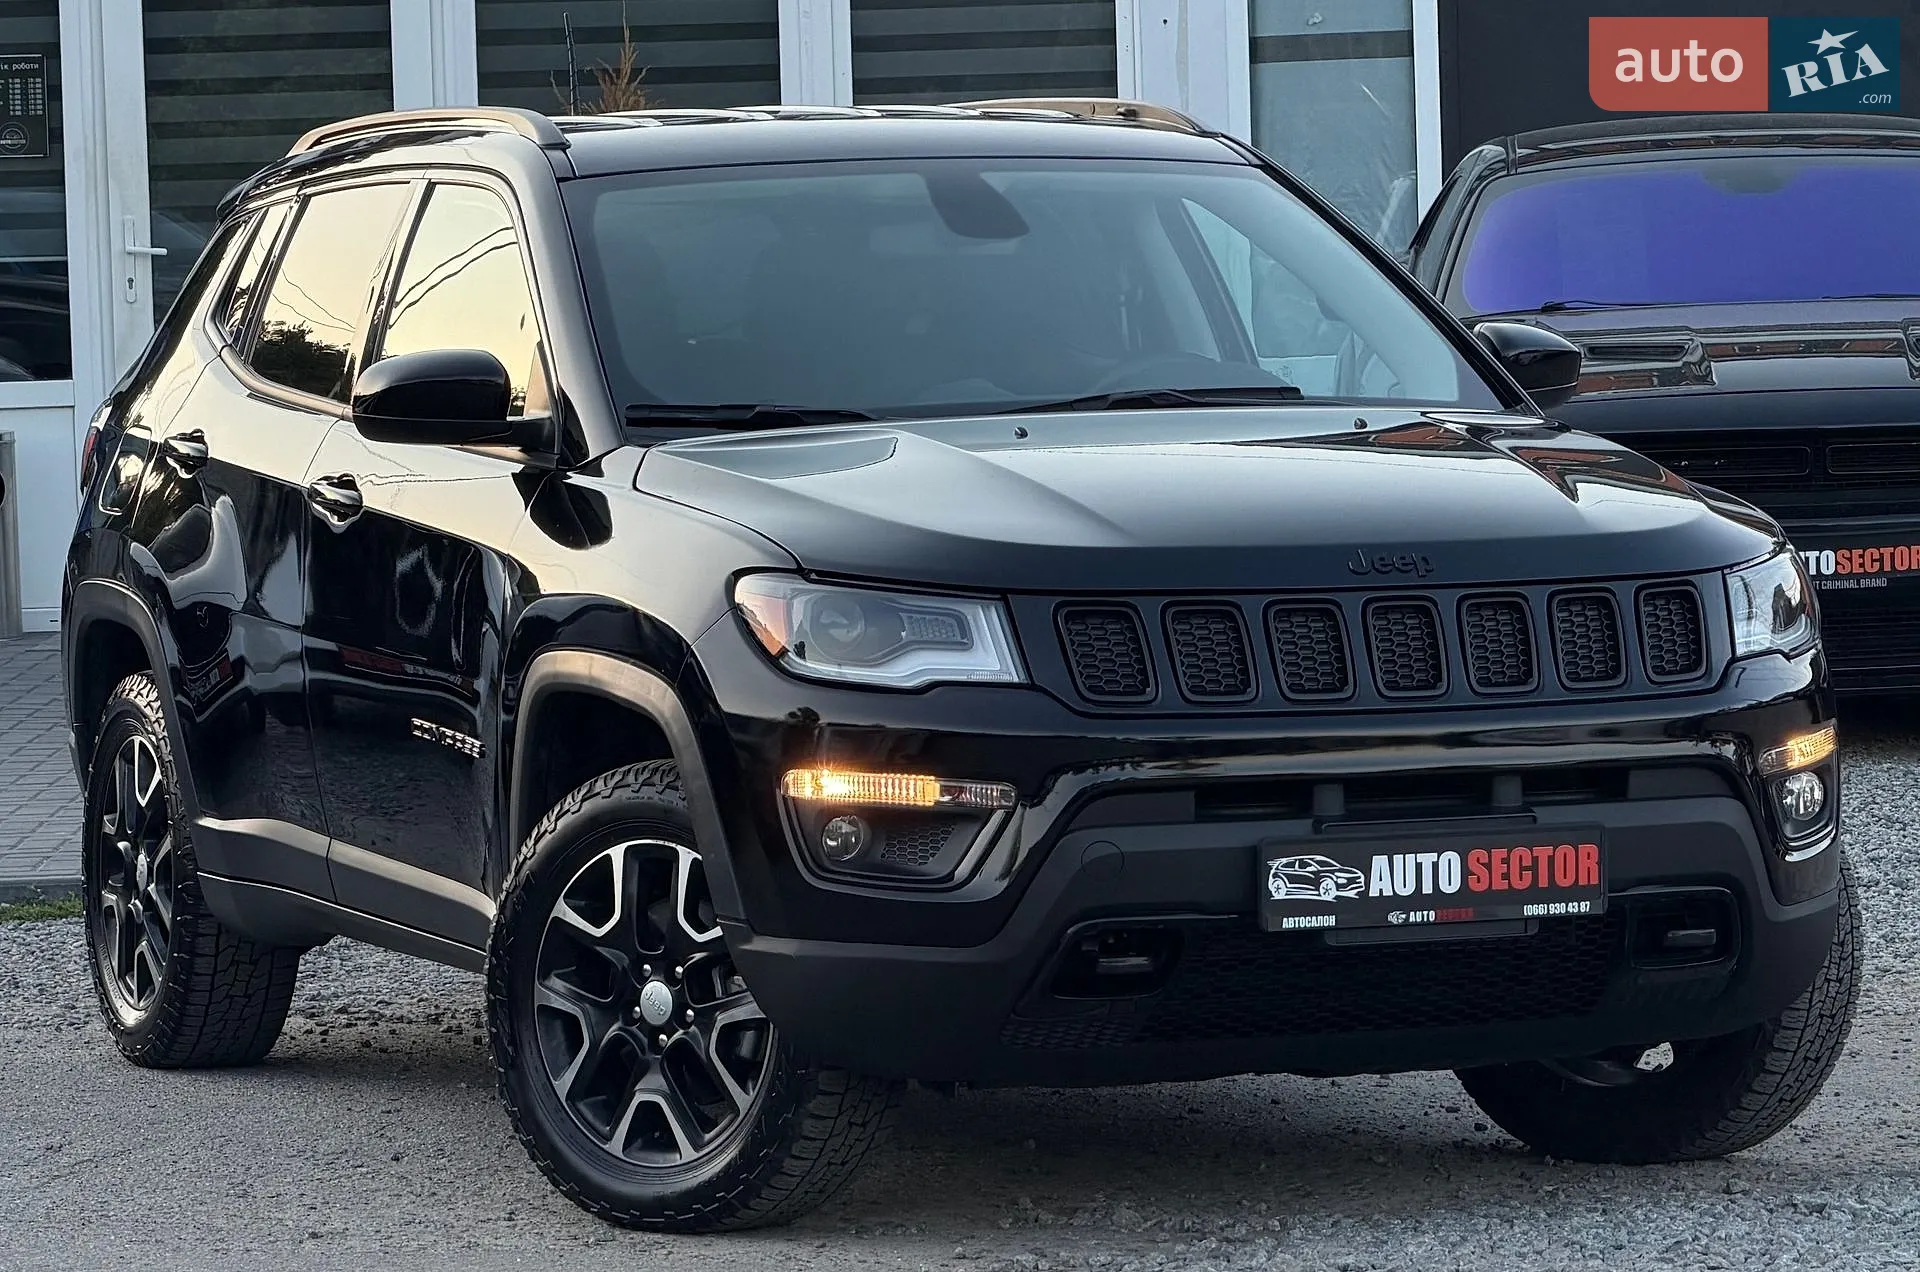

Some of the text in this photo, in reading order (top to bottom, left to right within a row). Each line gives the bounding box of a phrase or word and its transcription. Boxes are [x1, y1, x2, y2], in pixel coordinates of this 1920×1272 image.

[1347, 549, 1434, 578] Jeep
[1821, 579, 1859, 590] CRIMINAL
[1860, 577, 1887, 588] BRAND
[1368, 844, 1599, 897] AUTO SECTOR
[1523, 900, 1591, 916] (066) 930 43 87
[1282, 915, 1336, 929] АВТОСАЛОН
